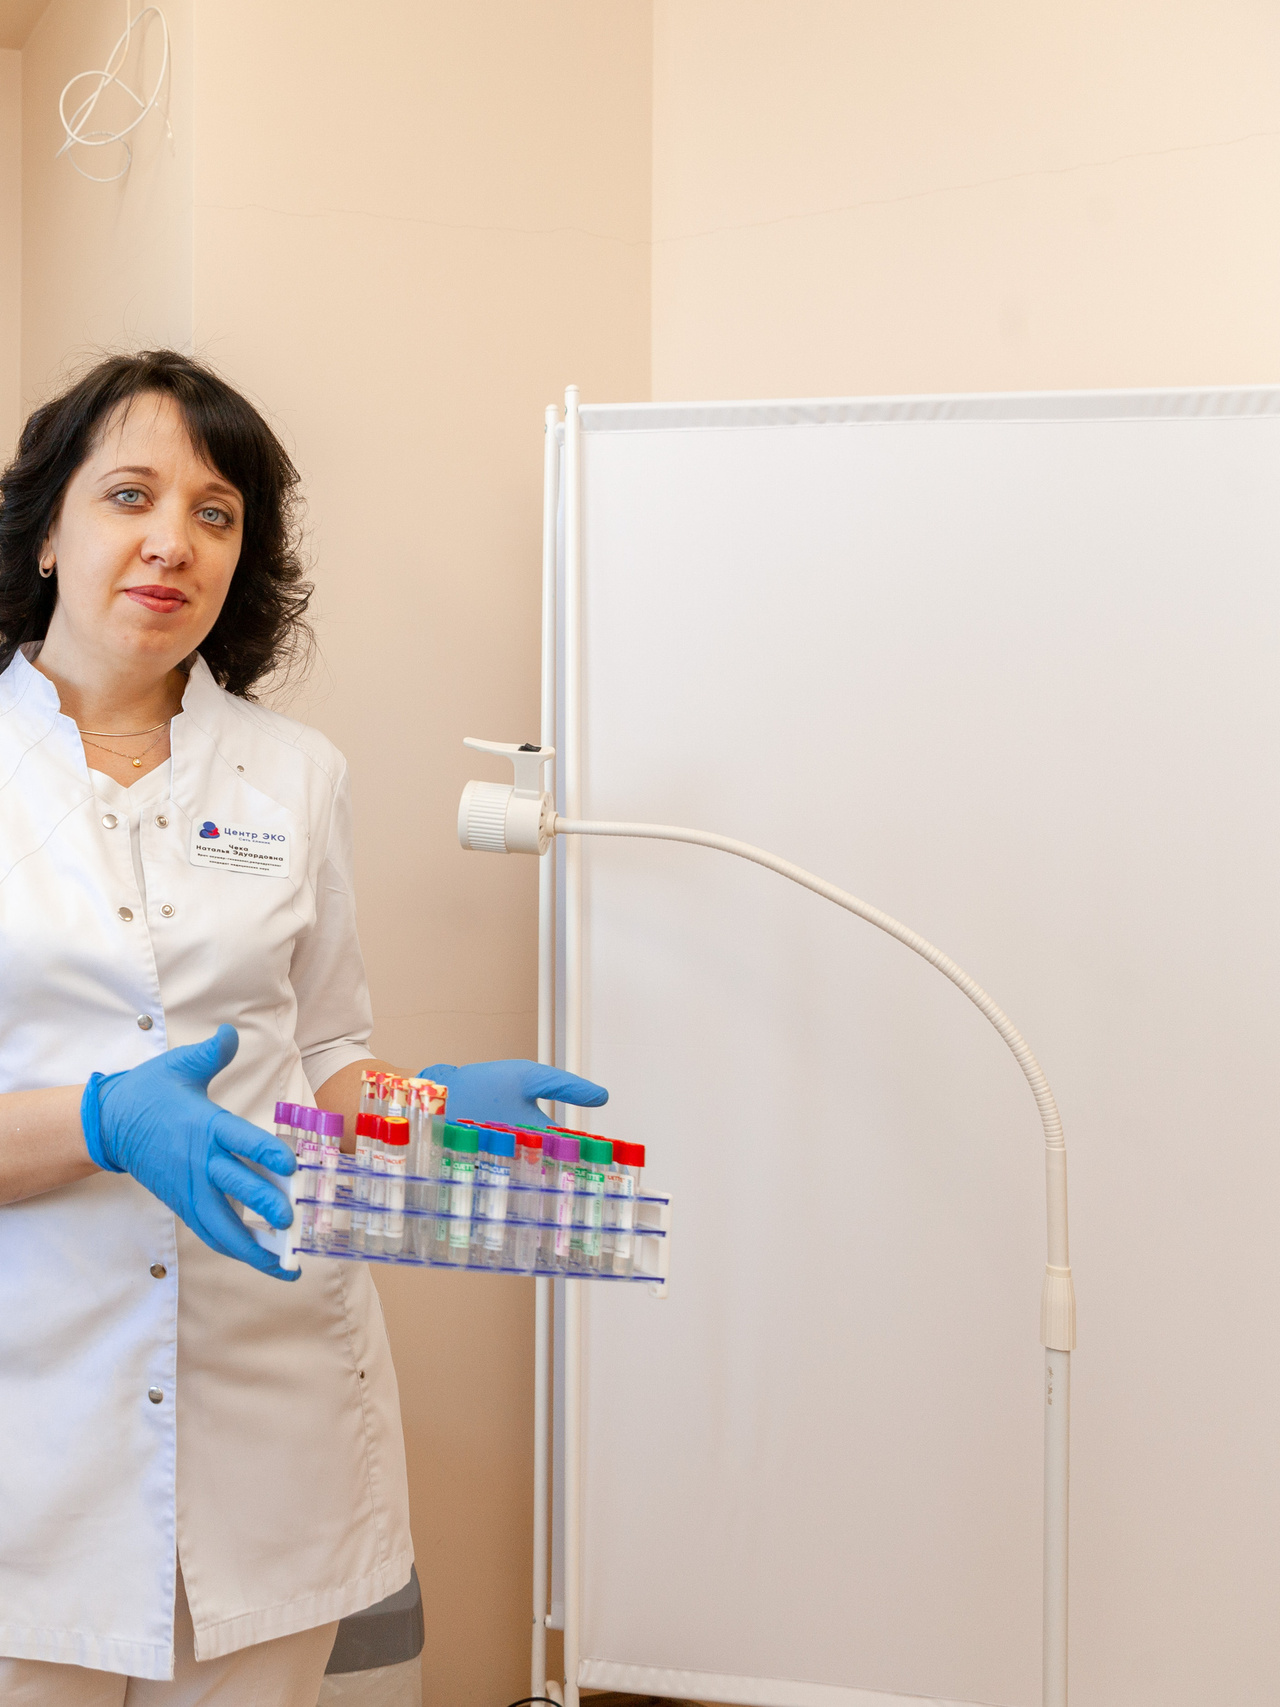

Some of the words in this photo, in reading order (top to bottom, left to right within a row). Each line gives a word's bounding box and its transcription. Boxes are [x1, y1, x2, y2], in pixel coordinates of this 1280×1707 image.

[224, 827, 258, 839] Центр
[262, 832, 286, 842] ЭКО
[196, 845, 230, 854] Наталья
[232, 850, 284, 862] Эдуардовна
